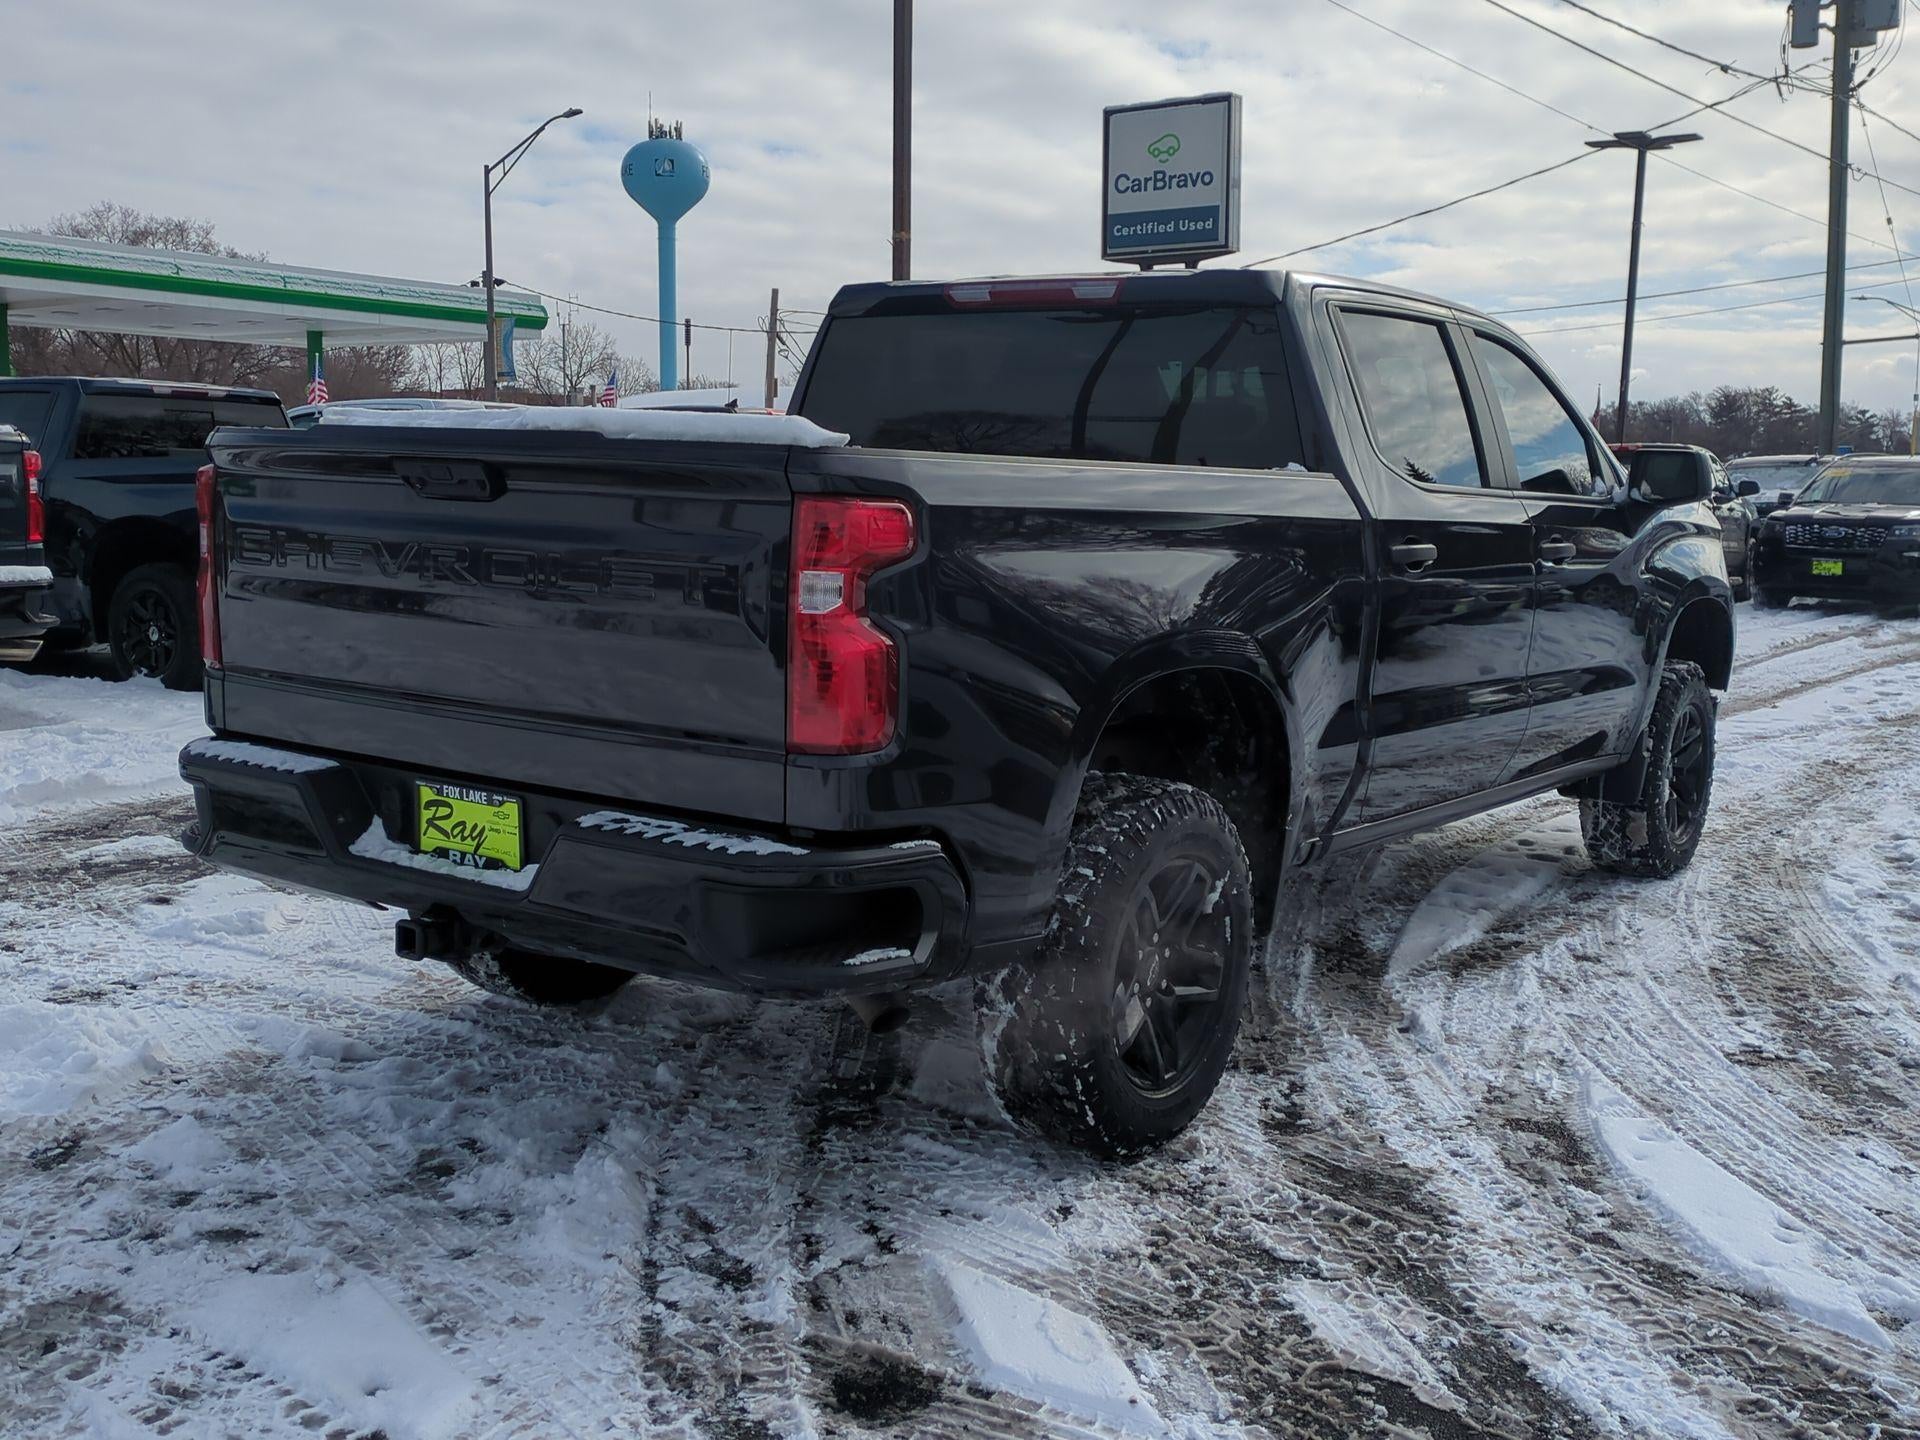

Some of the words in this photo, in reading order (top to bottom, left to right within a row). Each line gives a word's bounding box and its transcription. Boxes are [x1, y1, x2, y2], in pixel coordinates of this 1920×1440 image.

[1114, 169, 1214, 194] CarBravo
[1113, 221, 1175, 236] Certified
[1179, 218, 1213, 231] Used
[233, 526, 727, 606] CHEVROLET
[443, 785, 461, 799] FOX
[463, 788, 488, 804] LAKE
[423, 798, 488, 855] Ray
[448, 850, 487, 868] RAY
